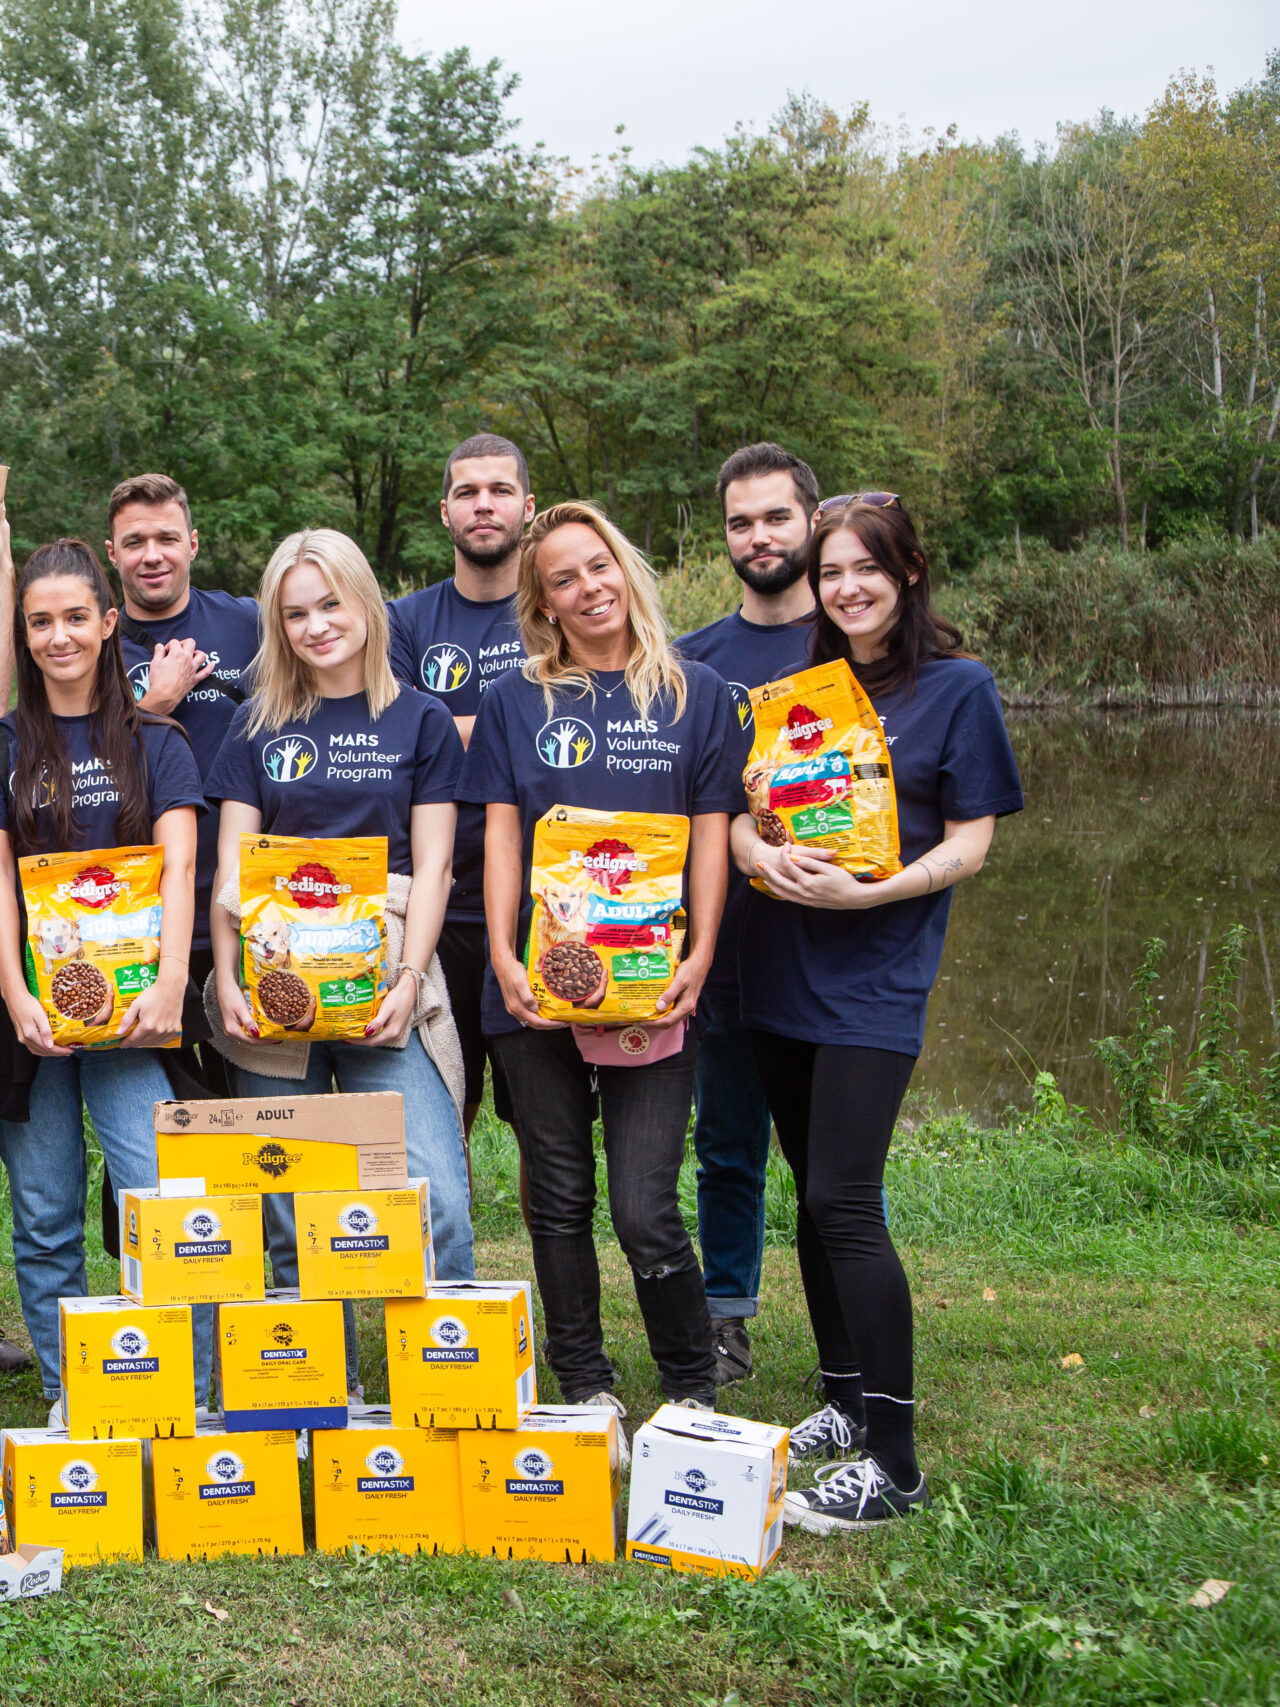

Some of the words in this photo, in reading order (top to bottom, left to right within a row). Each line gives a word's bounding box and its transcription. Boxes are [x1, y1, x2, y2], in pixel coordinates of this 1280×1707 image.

[478, 640, 521, 660] MARS
[478, 657, 527, 675] Volunte
[606, 719, 658, 733] MARS
[778, 717, 834, 741] Pedigree
[329, 733, 379, 747] MARS
[606, 737, 681, 754] Volunteer
[328, 750, 402, 764] Volunteer
[606, 755, 673, 774] Program
[327, 767, 392, 782] Program
[569, 850, 649, 873] Pedigree
[57, 881, 130, 900] Pedigree
[274, 876, 352, 896] Pedigree
[593, 904, 656, 919] ADULT
[533, 983, 538, 991] 3
[256, 1108, 295, 1121] ADULT
[242, 1152, 304, 1166] Pedigree
[179, 1244, 227, 1254] DENTASTIX
[334, 1239, 384, 1249] DENTASTIX
[430, 1328, 469, 1337] Pedigree
[110, 1339, 150, 1348] Pedigree
[264, 1349, 304, 1358] DENTASTIX
[426, 1351, 475, 1360] DENTASTIX
[107, 1361, 155, 1371] DENTASTIX
[206, 1463, 245, 1472] Pedigree
[365, 1457, 405, 1466] Pedigree
[513, 1459, 553, 1468] Pedigree
[59, 1472, 98, 1481] Pedigree
[674, 1471, 717, 1488] Pedigree
[203, 1485, 251, 1496] DENTASTIX
[361, 1480, 410, 1489] DENTASTIX
[510, 1483, 559, 1492] DENTASTIX
[55, 1495, 103, 1504] DENTASTIX
[669, 1494, 720, 1511] DENTASTIX
[672, 1508, 691, 1517] DAILY
[692, 1511, 715, 1521] FRESH
[634, 1552, 669, 1563] DENTASTIX
[22, 1573, 49, 1593] Rodeo
